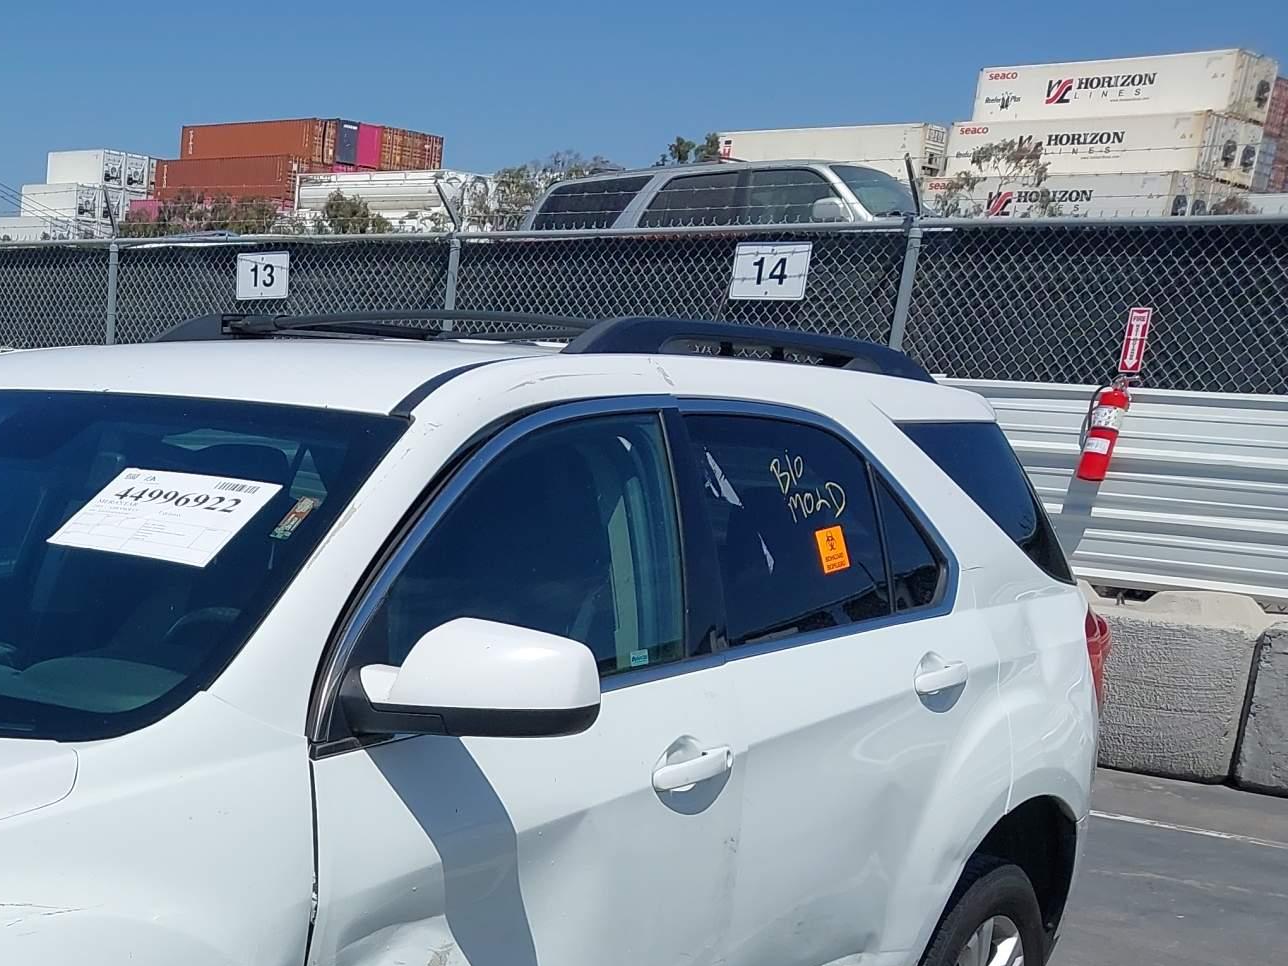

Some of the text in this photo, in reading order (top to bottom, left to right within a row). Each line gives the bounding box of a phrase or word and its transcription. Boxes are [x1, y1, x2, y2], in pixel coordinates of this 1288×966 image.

[988, 71, 1018, 81] seaco
[1076, 72, 1157, 89] HORIZON
[1074, 88, 1142, 100] LINES
[959, 126, 989, 135] seaco
[1046, 131, 1125, 147] HORIZON
[250, 263, 275, 288] 13
[753, 256, 788, 286] 14
[115, 486, 242, 514] 44996922
